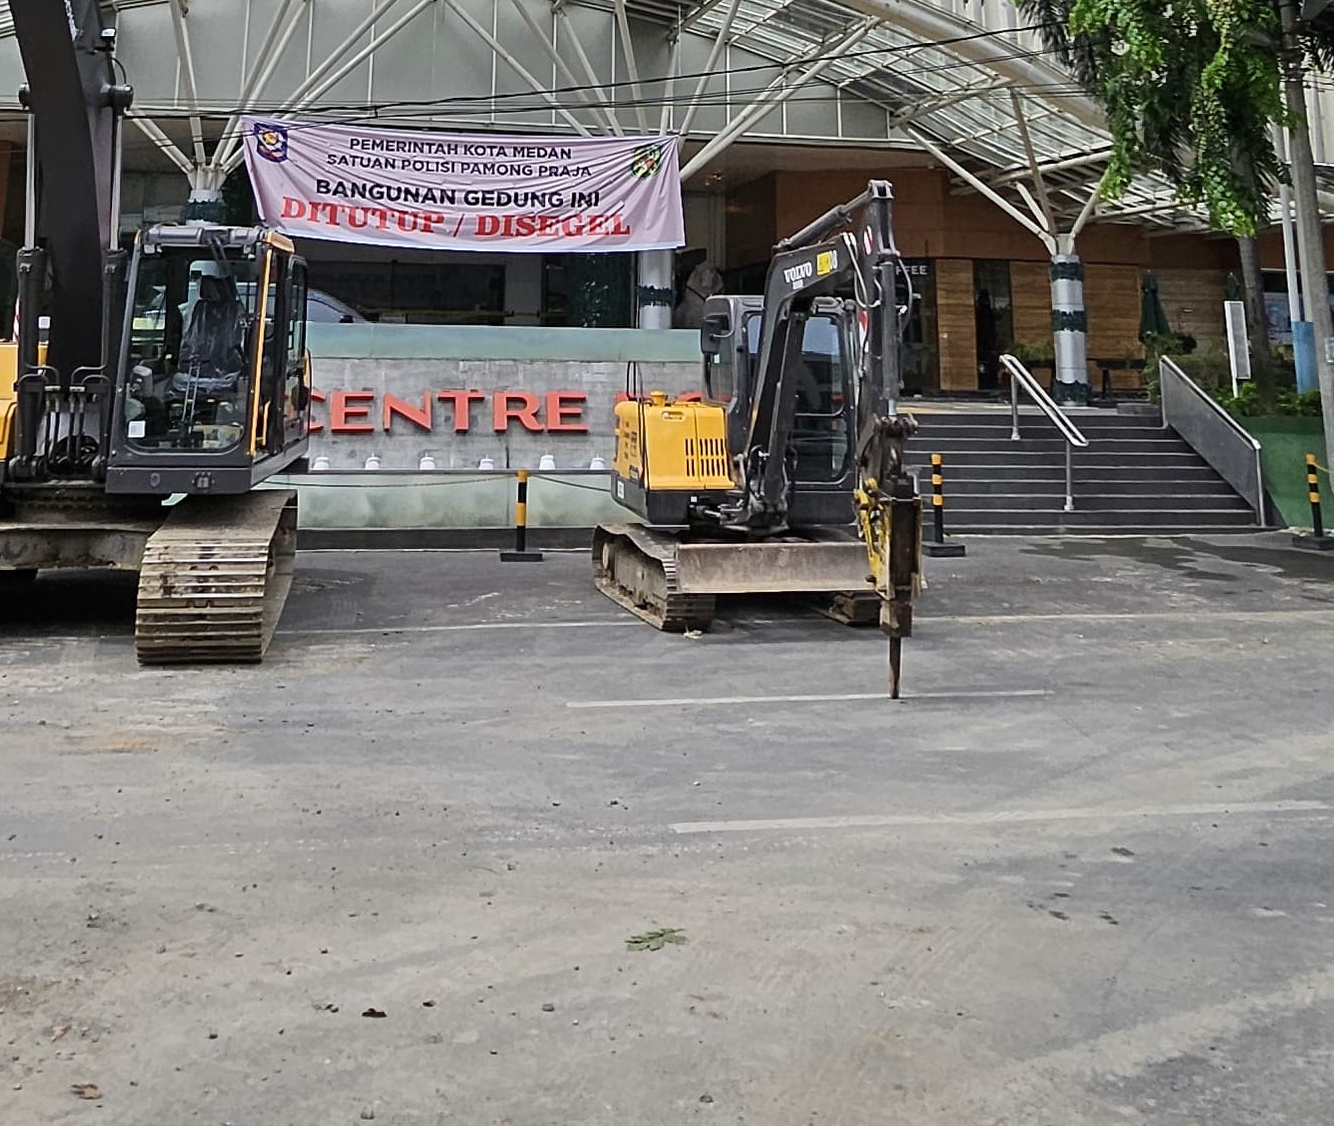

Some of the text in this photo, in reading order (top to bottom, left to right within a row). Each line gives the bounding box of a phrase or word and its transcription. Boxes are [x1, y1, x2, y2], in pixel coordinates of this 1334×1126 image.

[350, 138, 572, 160] PEMERINTAH KOTA MEDAN
[327, 154, 592, 178] SATUAN POLISI PAMONG PRAJA
[316, 179, 600, 208] BANGUNAN GEDUNG INI
[280, 196, 445, 234] DITUTUP
[474, 212, 633, 238] DISEGEL
[783, 261, 812, 283] VOLVO
